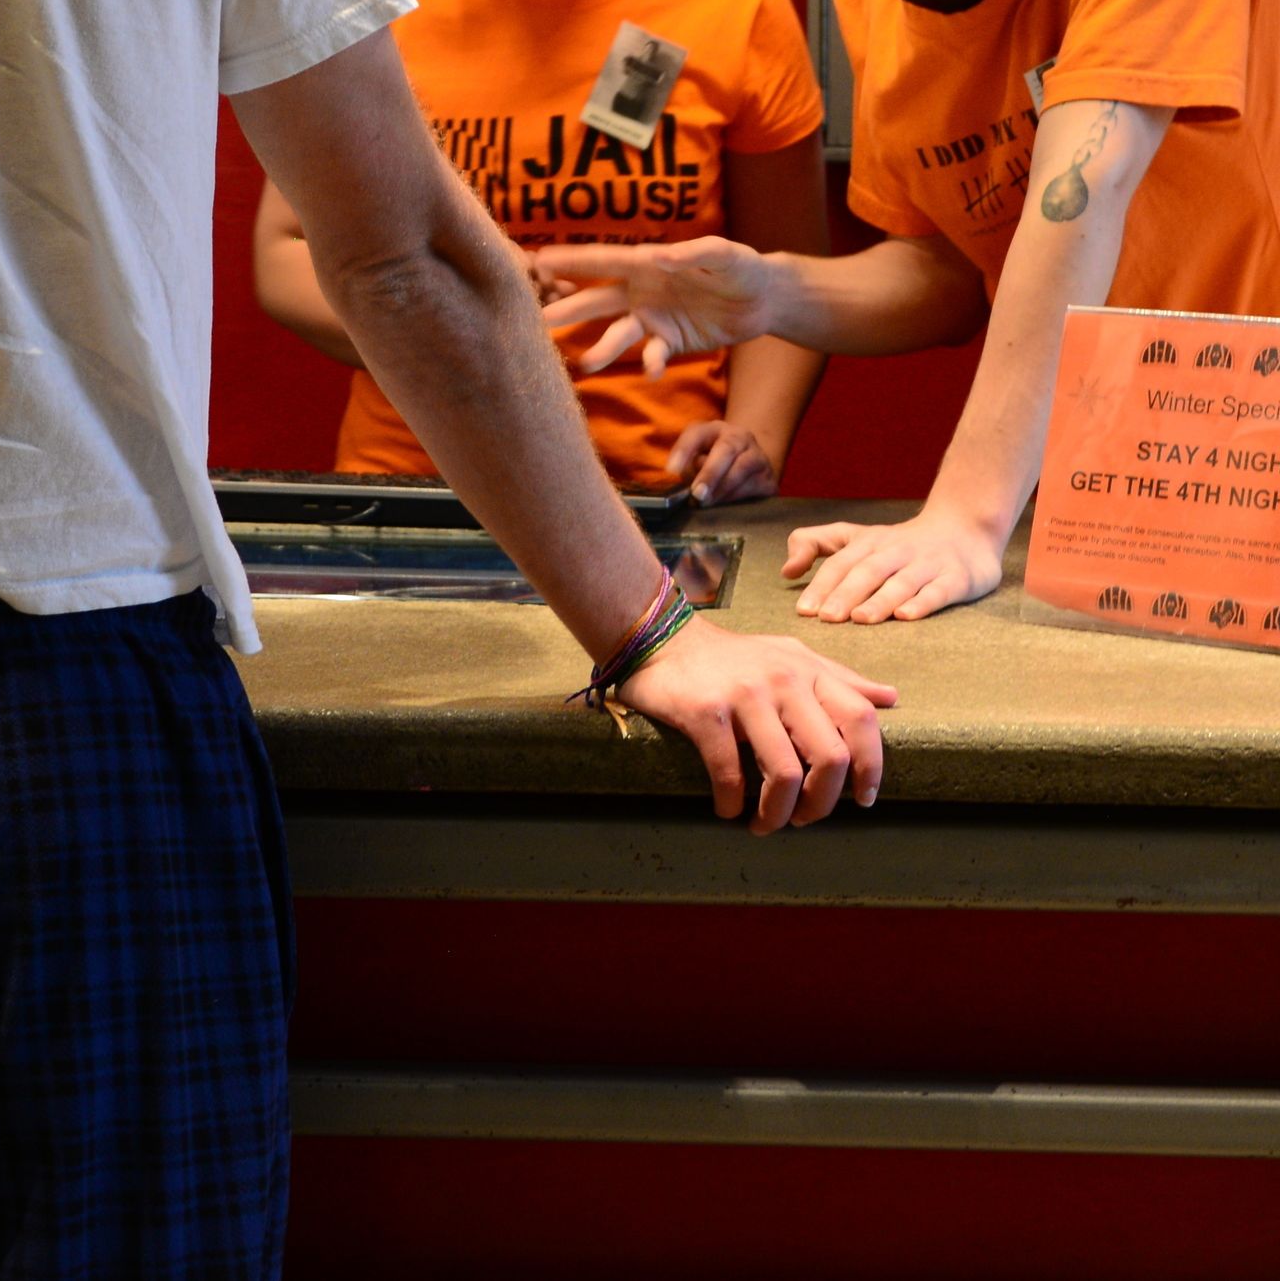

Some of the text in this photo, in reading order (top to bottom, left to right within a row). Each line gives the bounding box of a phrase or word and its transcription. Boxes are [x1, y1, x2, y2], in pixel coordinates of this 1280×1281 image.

[522, 113, 699, 177] JAIL
[916, 147, 930, 169] I
[932, 133, 986, 167] DID
[522, 180, 699, 222] HOUSE
[1147, 389, 1215, 415] Winter
[1137, 440, 1200, 465] STAY
[1205, 447, 1219, 466] 4
[1070, 470, 1118, 494] GET
[1124, 475, 1170, 499] THE
[1176, 481, 1221, 504] 4TH
[1050, 516, 1076, 527] Please
